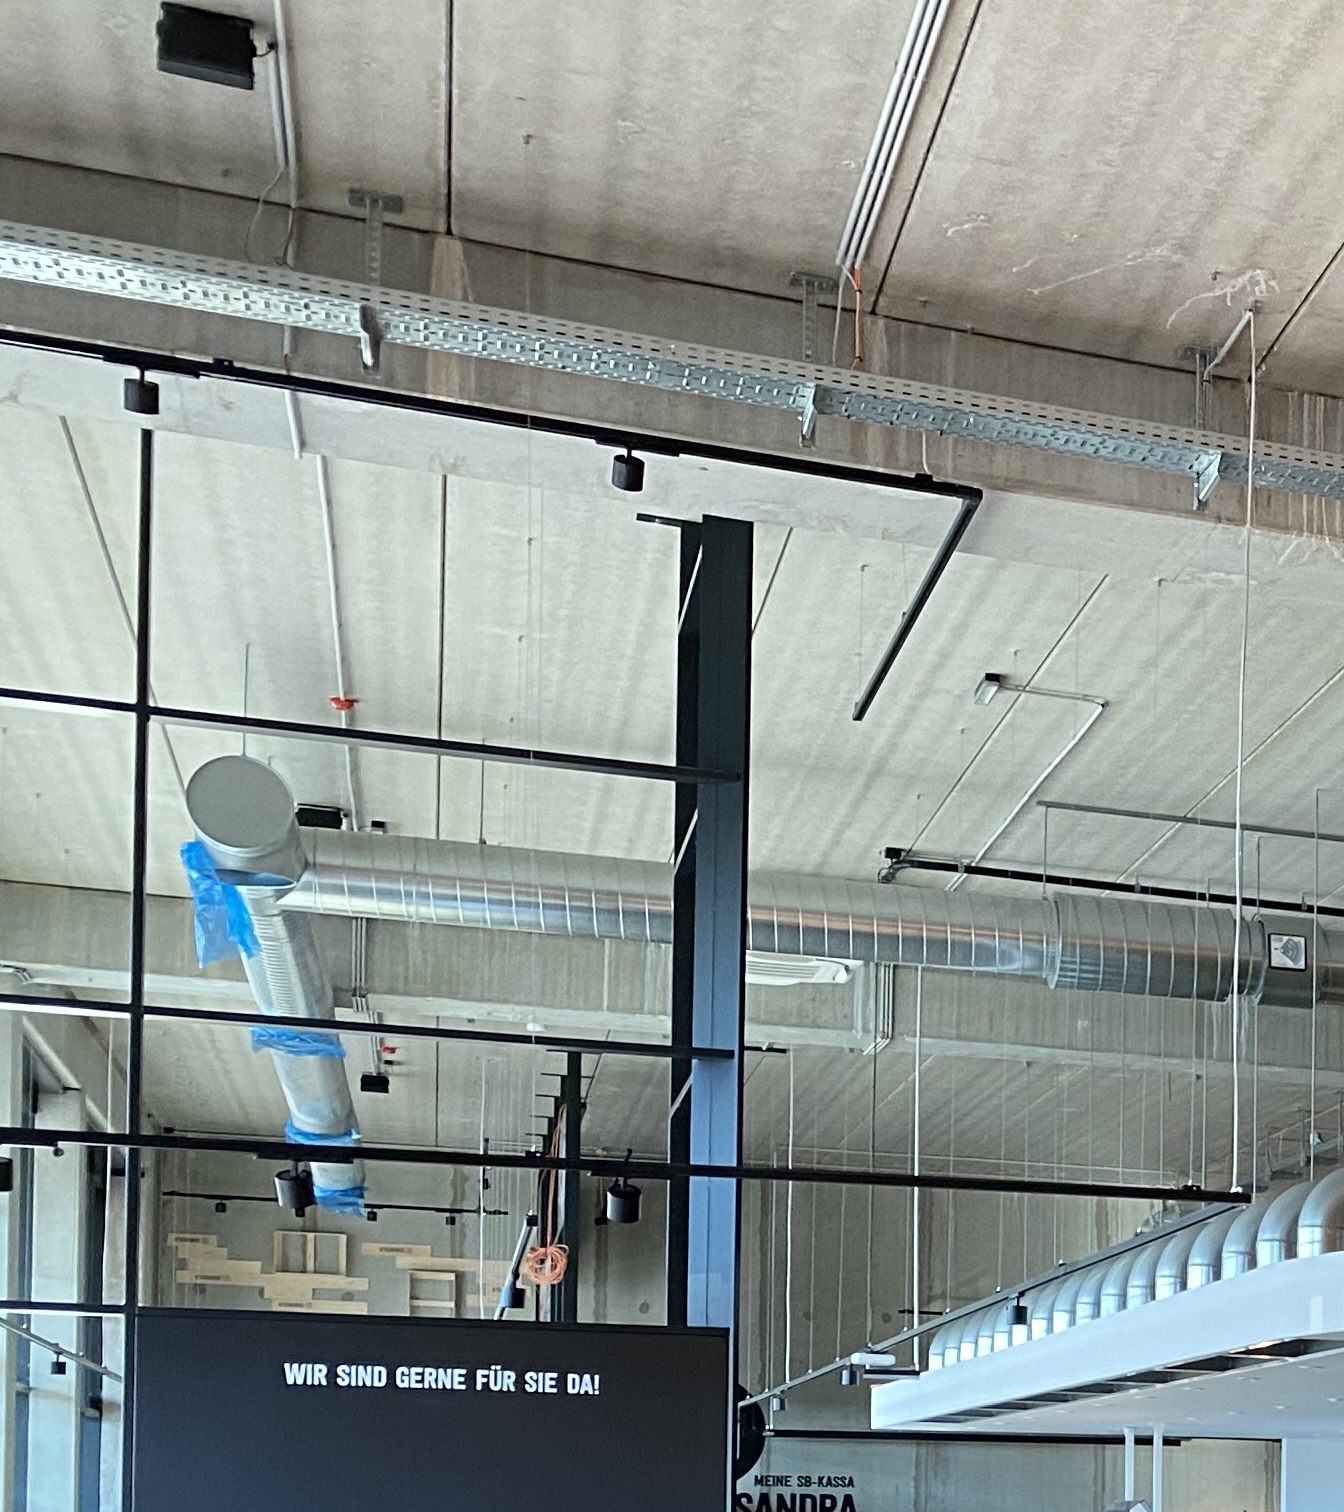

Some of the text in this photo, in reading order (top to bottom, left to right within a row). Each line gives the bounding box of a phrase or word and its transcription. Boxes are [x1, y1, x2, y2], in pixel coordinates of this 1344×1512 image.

[284, 1362, 600, 1395] WIR SIND GERNE FÜR SIE DA!
[754, 1475, 855, 1488] MEINE SB-KASSA
